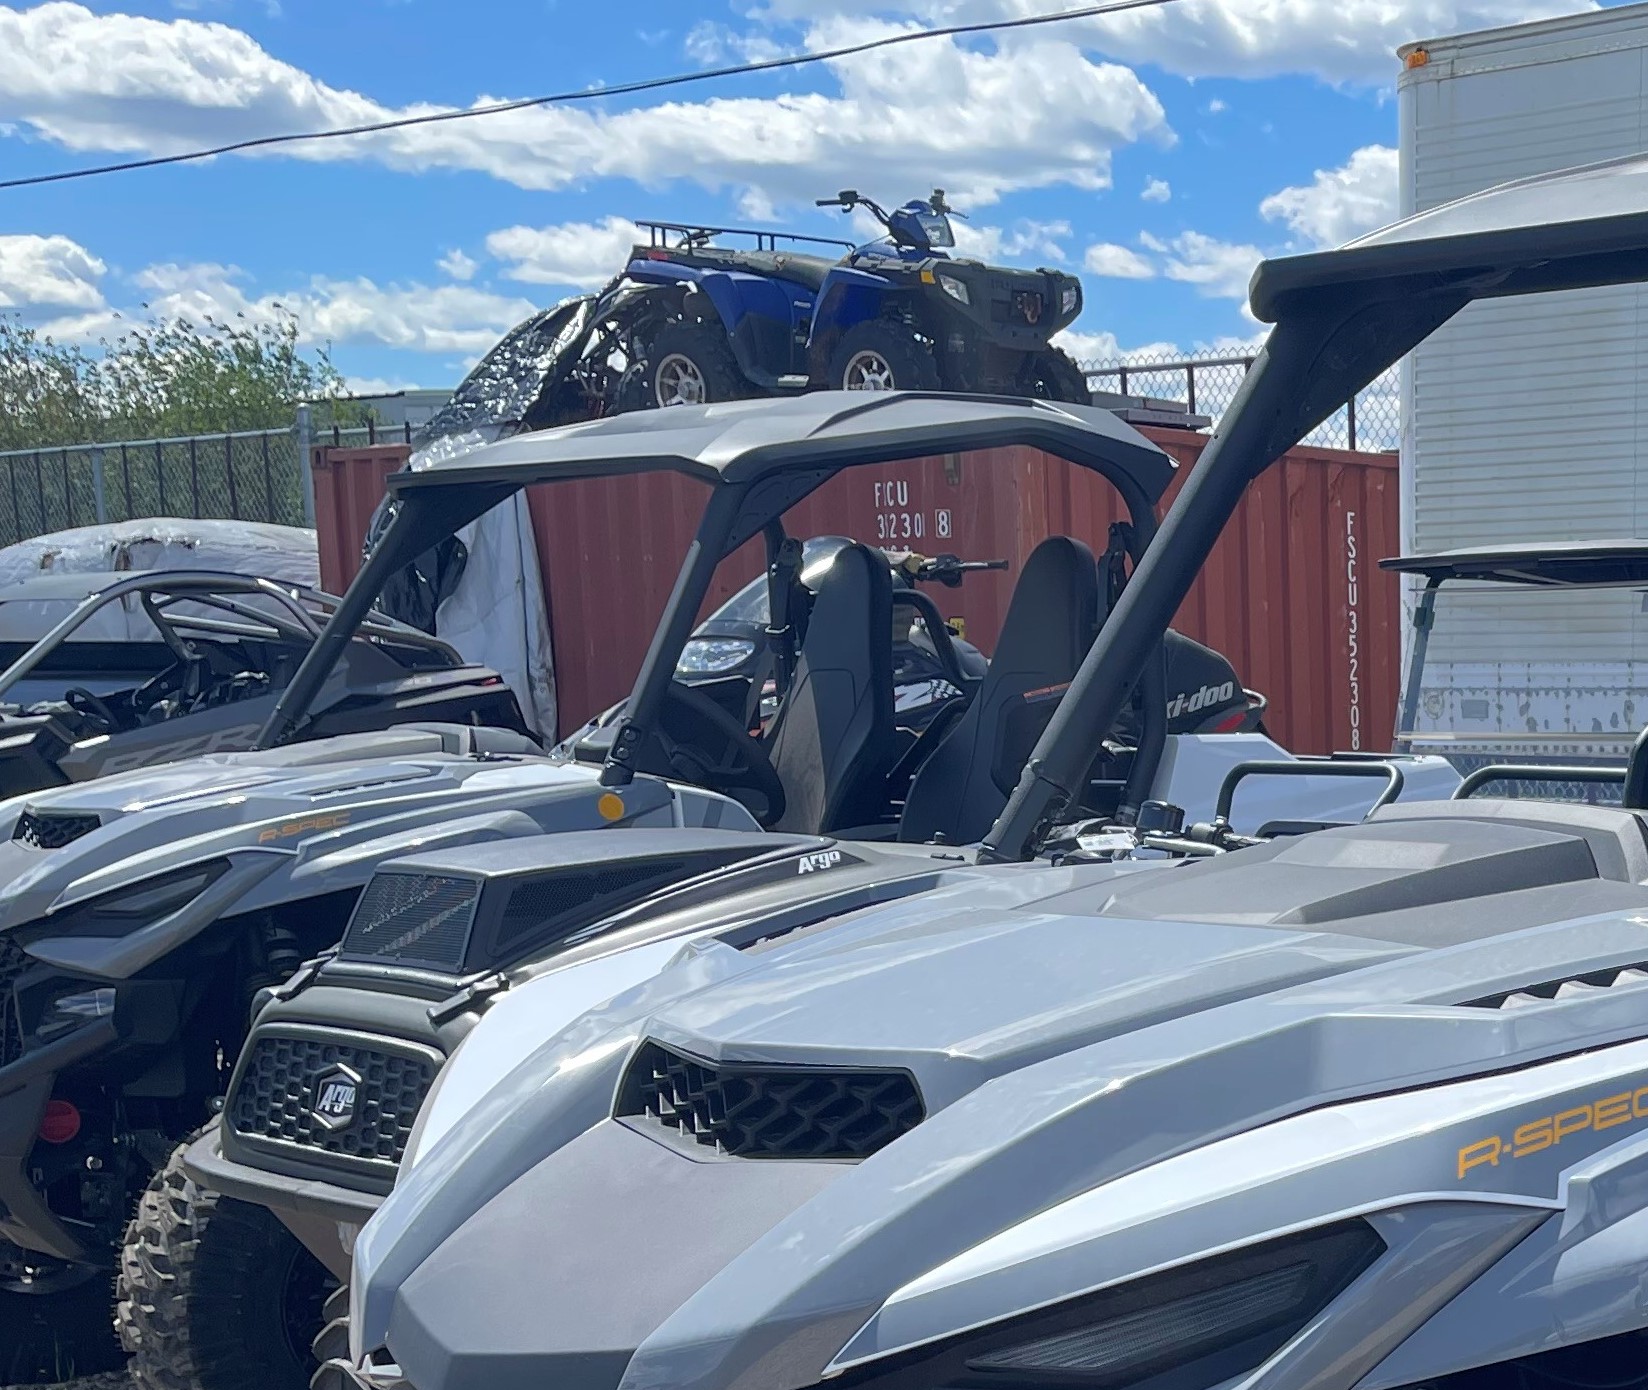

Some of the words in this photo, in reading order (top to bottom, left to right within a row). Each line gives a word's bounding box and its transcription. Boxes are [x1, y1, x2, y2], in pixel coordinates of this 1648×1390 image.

[874, 481, 908, 507] FCU
[937, 511, 949, 536] 8
[798, 851, 841, 874] Argo
